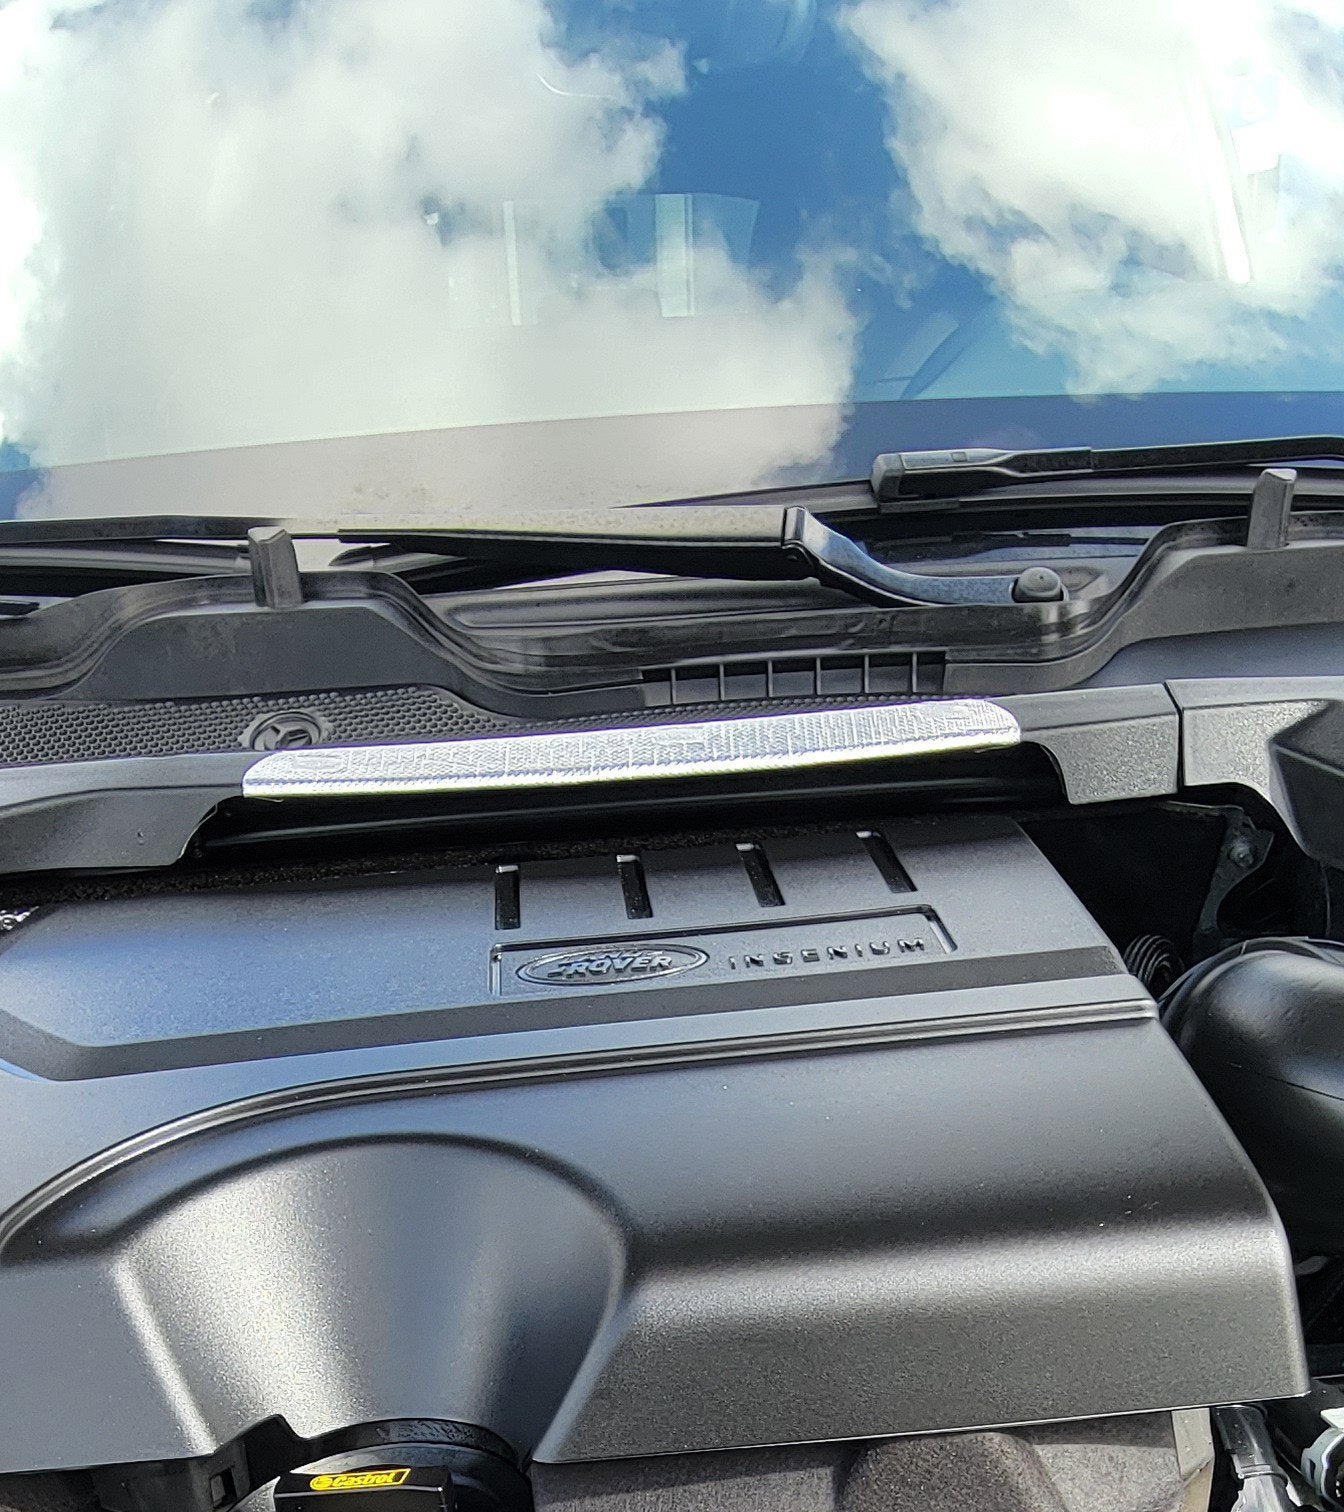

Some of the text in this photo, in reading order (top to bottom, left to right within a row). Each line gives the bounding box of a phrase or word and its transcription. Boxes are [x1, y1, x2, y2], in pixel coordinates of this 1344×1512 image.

[728, 936, 925, 970] INGENIUM
[565, 956, 673, 979] ROVER
[331, 1471, 396, 1488] Castrol
